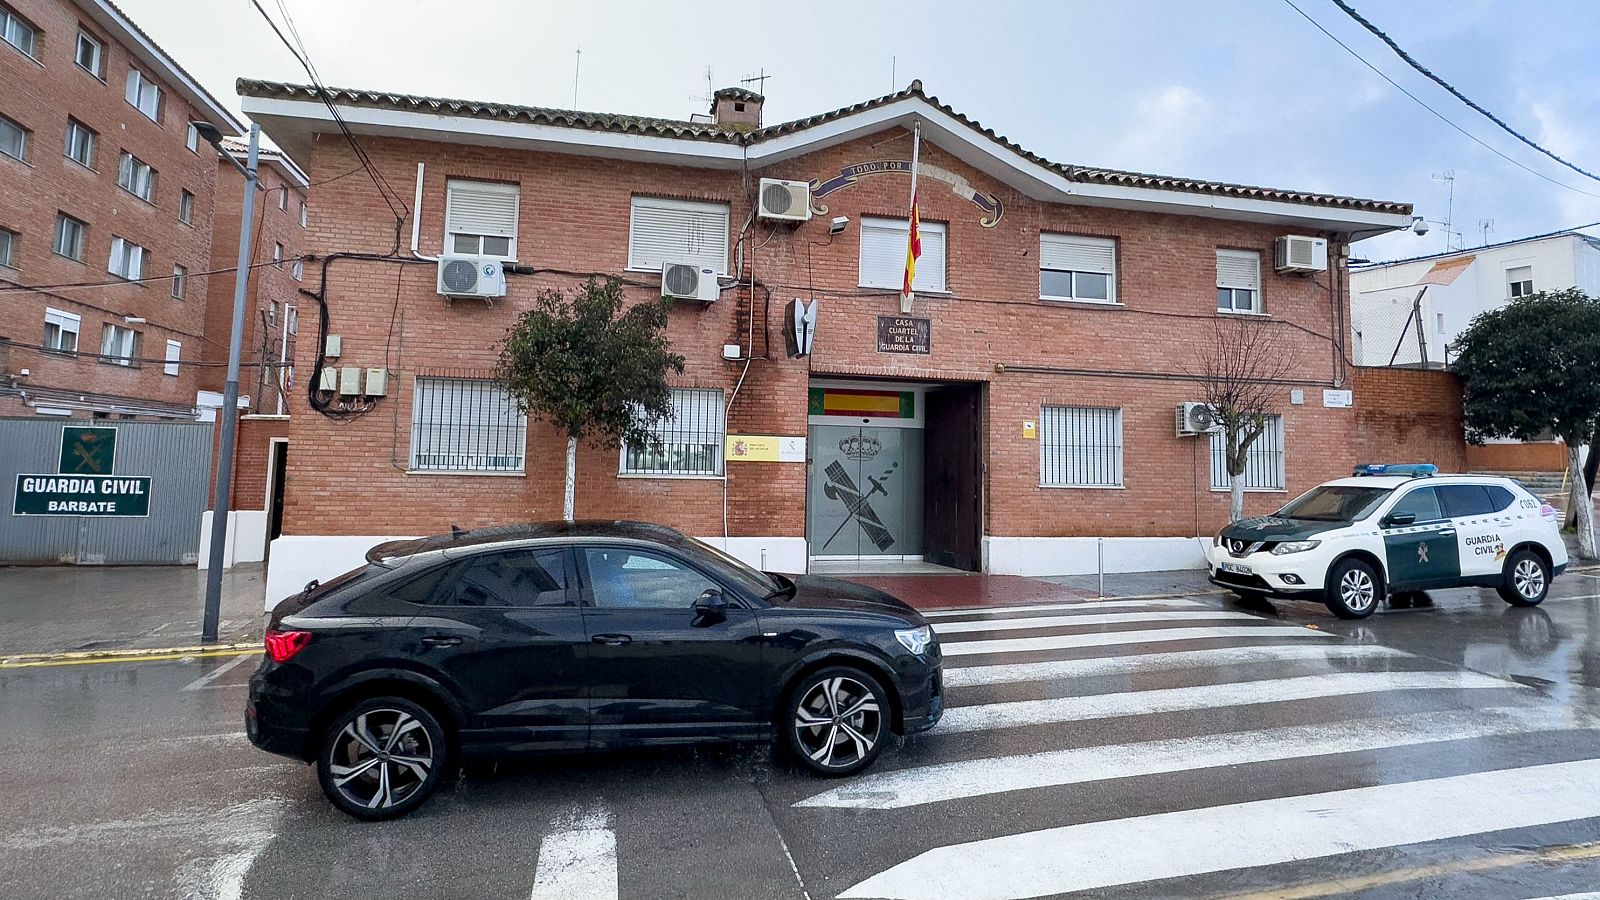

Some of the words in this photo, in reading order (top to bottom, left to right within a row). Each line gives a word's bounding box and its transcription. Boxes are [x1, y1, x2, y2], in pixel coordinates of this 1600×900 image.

[851, 163, 876, 174] TODO
[883, 162, 902, 171] POR
[895, 319, 913, 327] CASA
[888, 327, 918, 336] CUARTEL
[881, 343, 909, 352] GUARDIA
[23, 478, 96, 494] GUARDIA
[101, 479, 144, 495] CIVIL
[48, 501, 116, 512] BARBATE
[1465, 533, 1501, 546] GUARDIA
[1475, 545, 1494, 555] CIVIL
